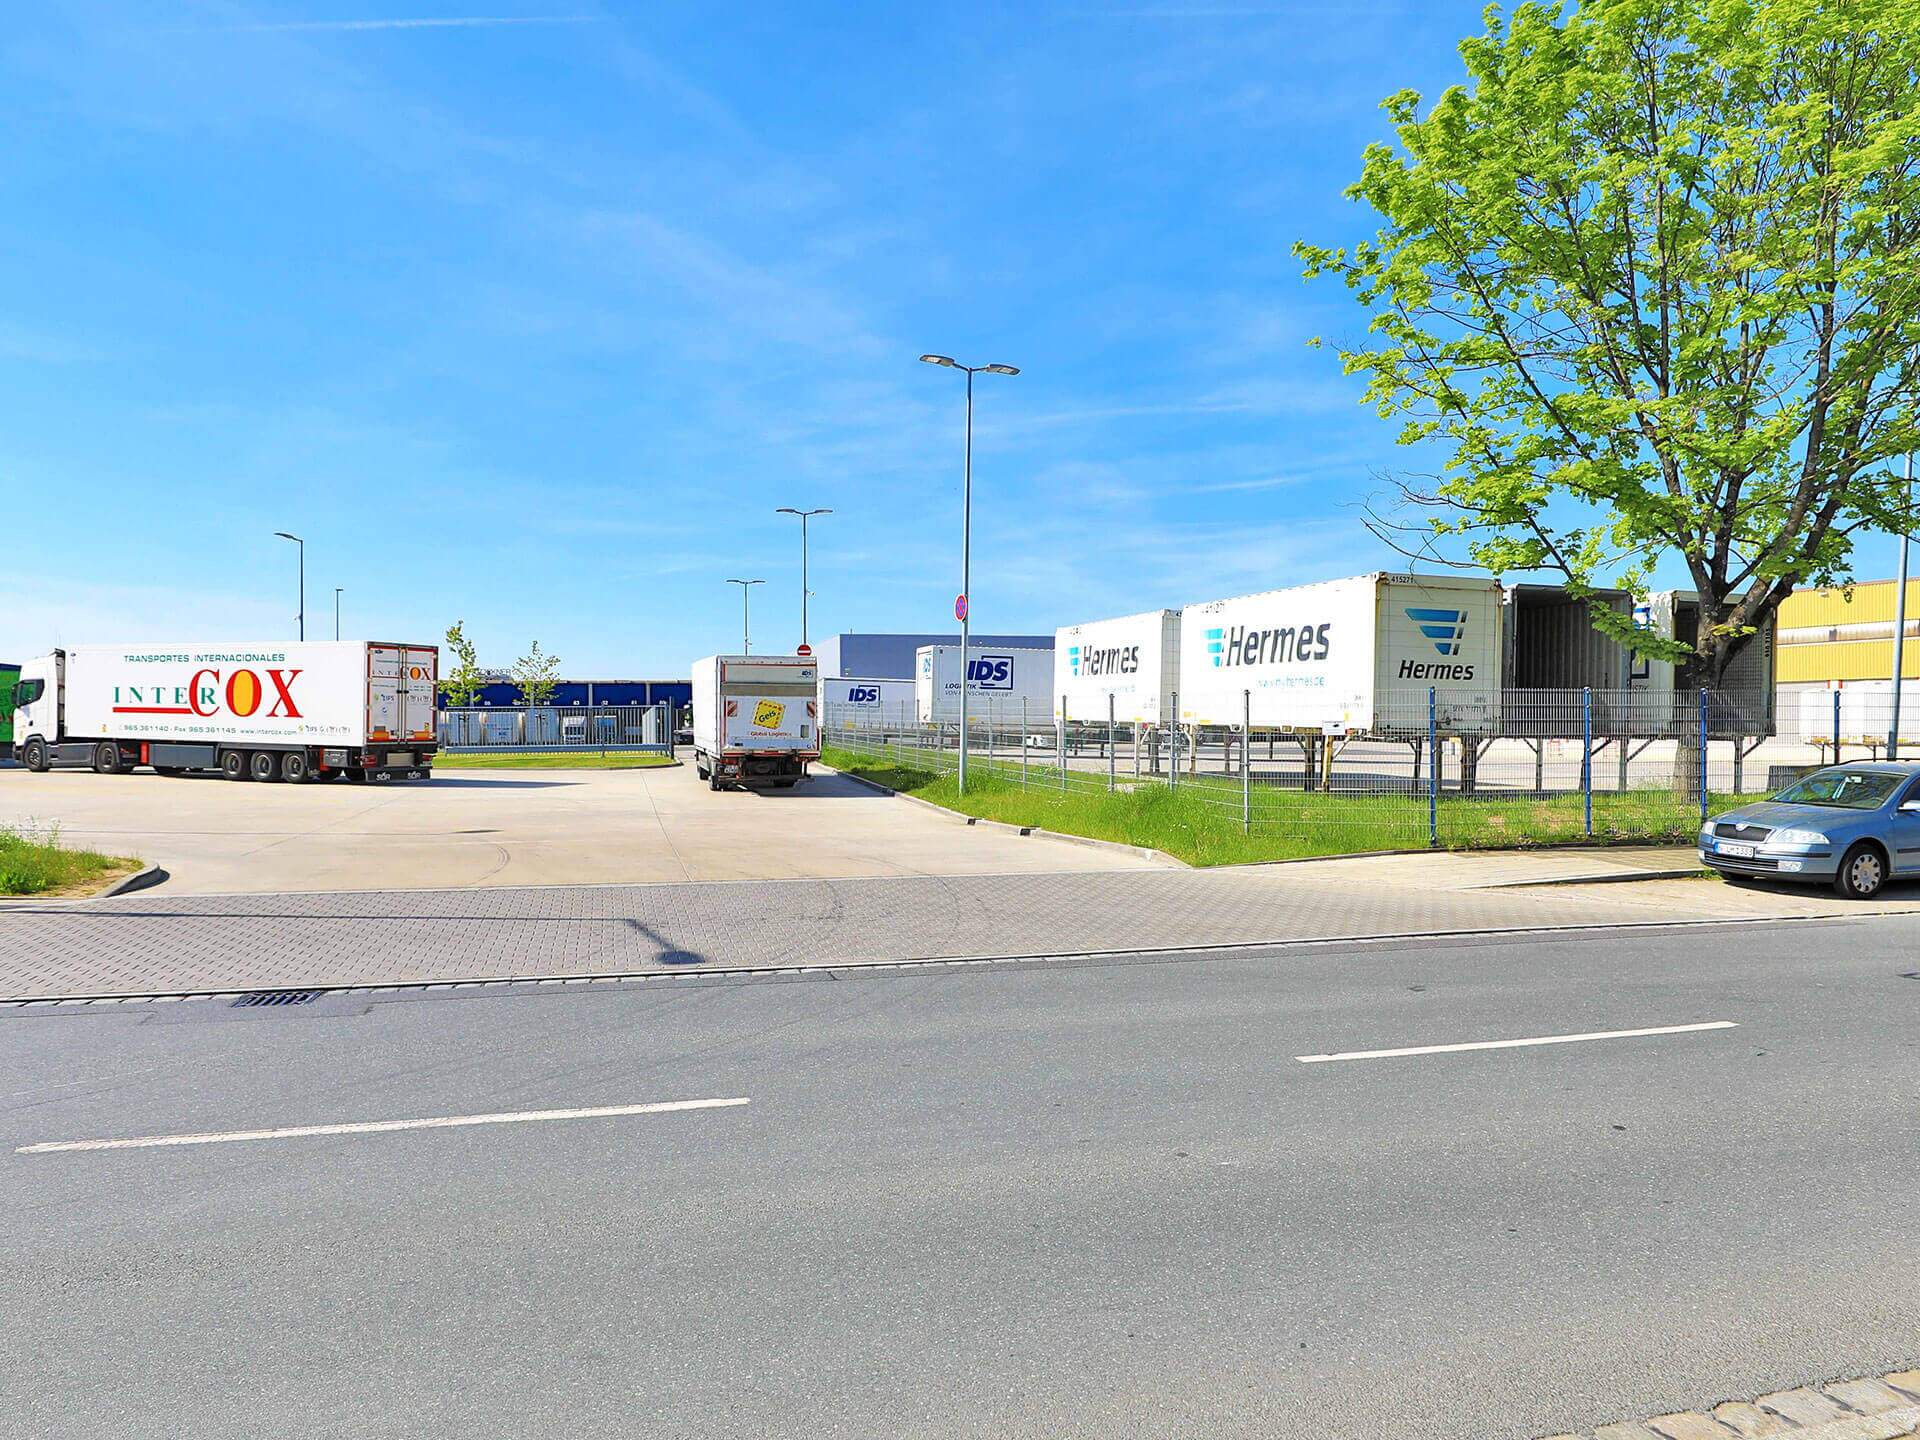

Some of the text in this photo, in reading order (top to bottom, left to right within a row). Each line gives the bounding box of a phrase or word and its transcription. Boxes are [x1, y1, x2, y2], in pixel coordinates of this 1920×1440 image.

[1226, 623, 1331, 667] Hermes
[124, 654, 286, 663] TRANSPORTES INTERNACIONALES
[1082, 645, 1139, 675] Hermes
[968, 660, 1008, 681] IDS
[1399, 660, 1474, 680] Hermes
[849, 687, 877, 702] IDS
[758, 710, 776, 723] Geis
